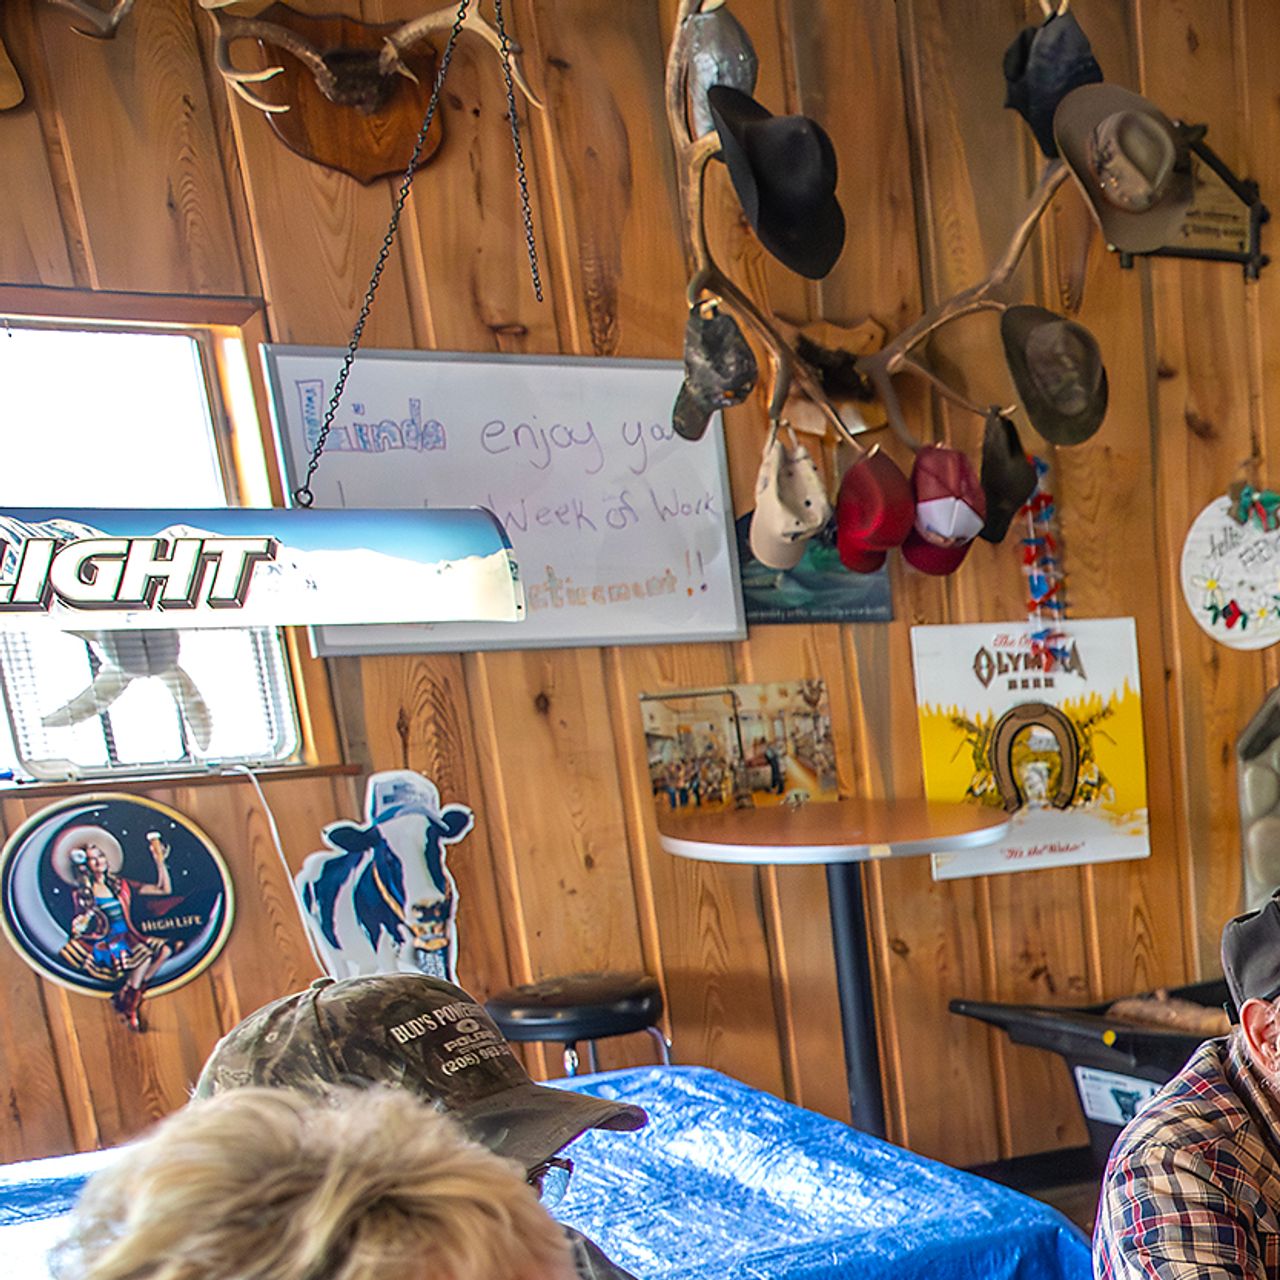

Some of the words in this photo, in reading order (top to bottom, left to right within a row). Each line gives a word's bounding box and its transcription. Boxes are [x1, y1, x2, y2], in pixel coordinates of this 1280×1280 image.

[295, 380, 446, 453] Linda
[481, 415, 605, 475] enjoy
[973, 639, 1087, 690] OLYMA
[141, 918, 175, 932] HIGH
[389, 1012, 439, 1045] BUD'S
